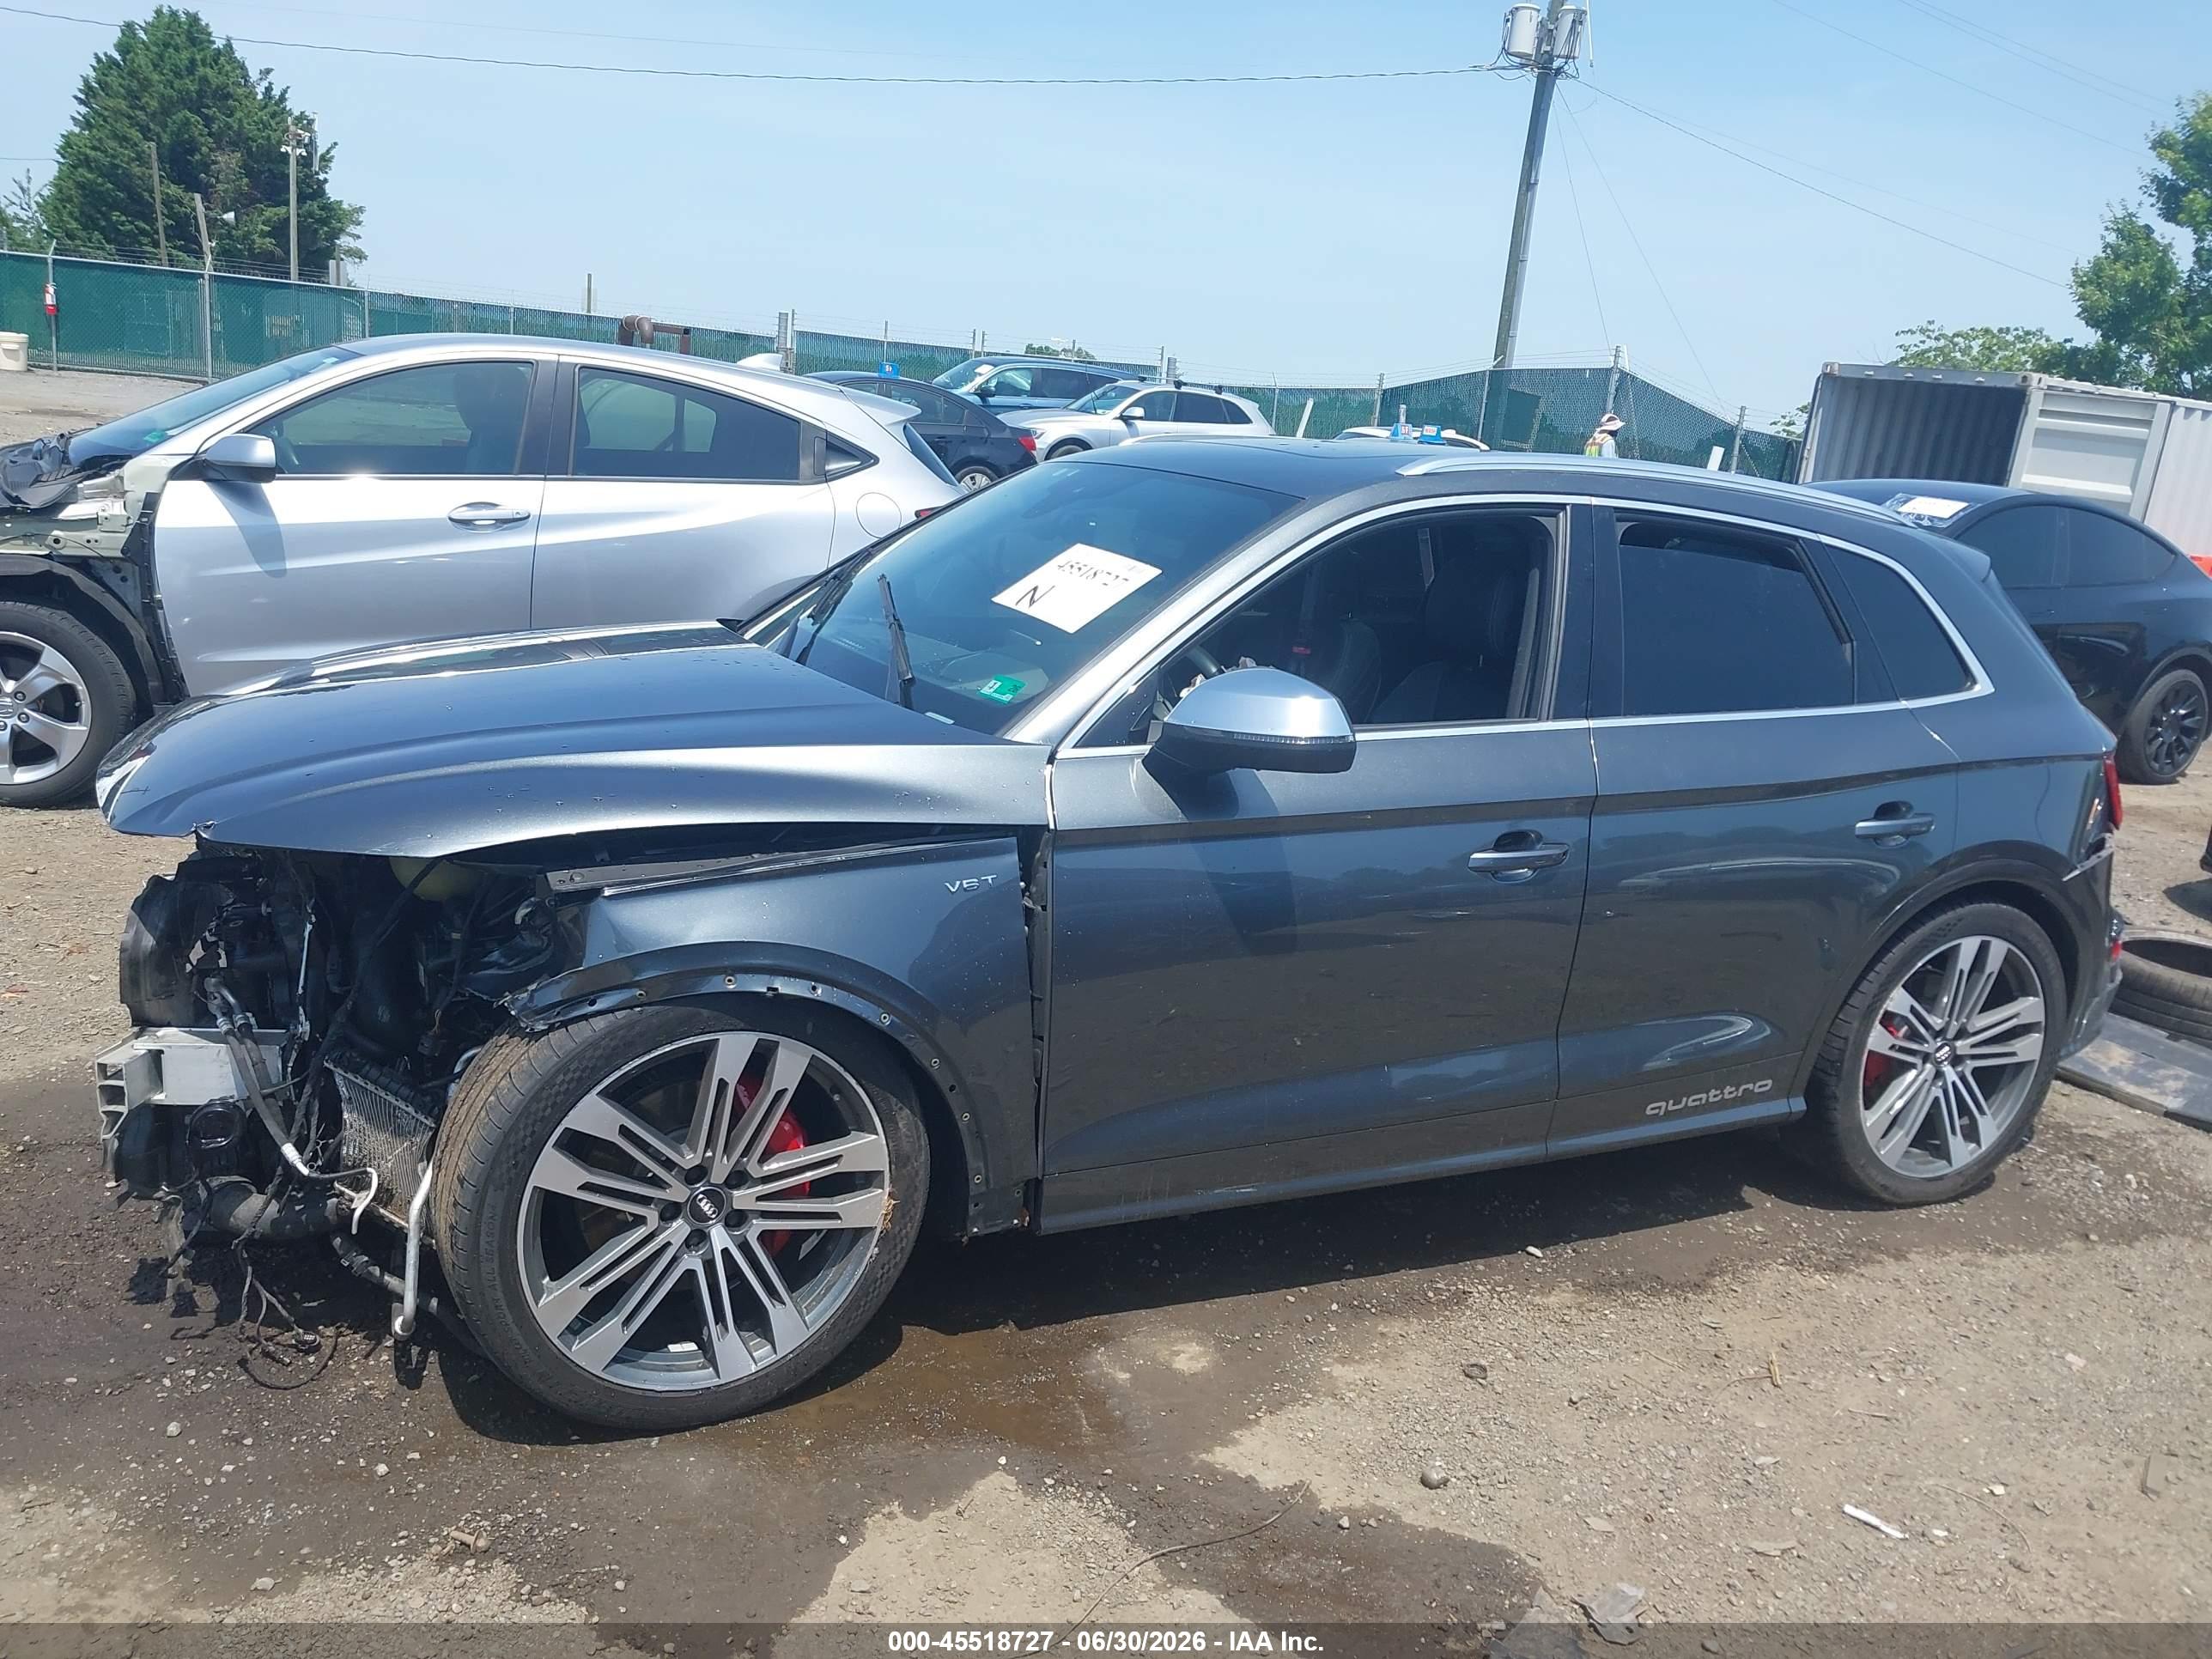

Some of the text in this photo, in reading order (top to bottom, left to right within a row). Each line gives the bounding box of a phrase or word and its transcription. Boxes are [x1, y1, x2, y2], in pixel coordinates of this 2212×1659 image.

[1014, 585, 1055, 609] N
[1645, 1079, 1773, 1116] quattro
[486, 1267, 497, 1291] ALL
